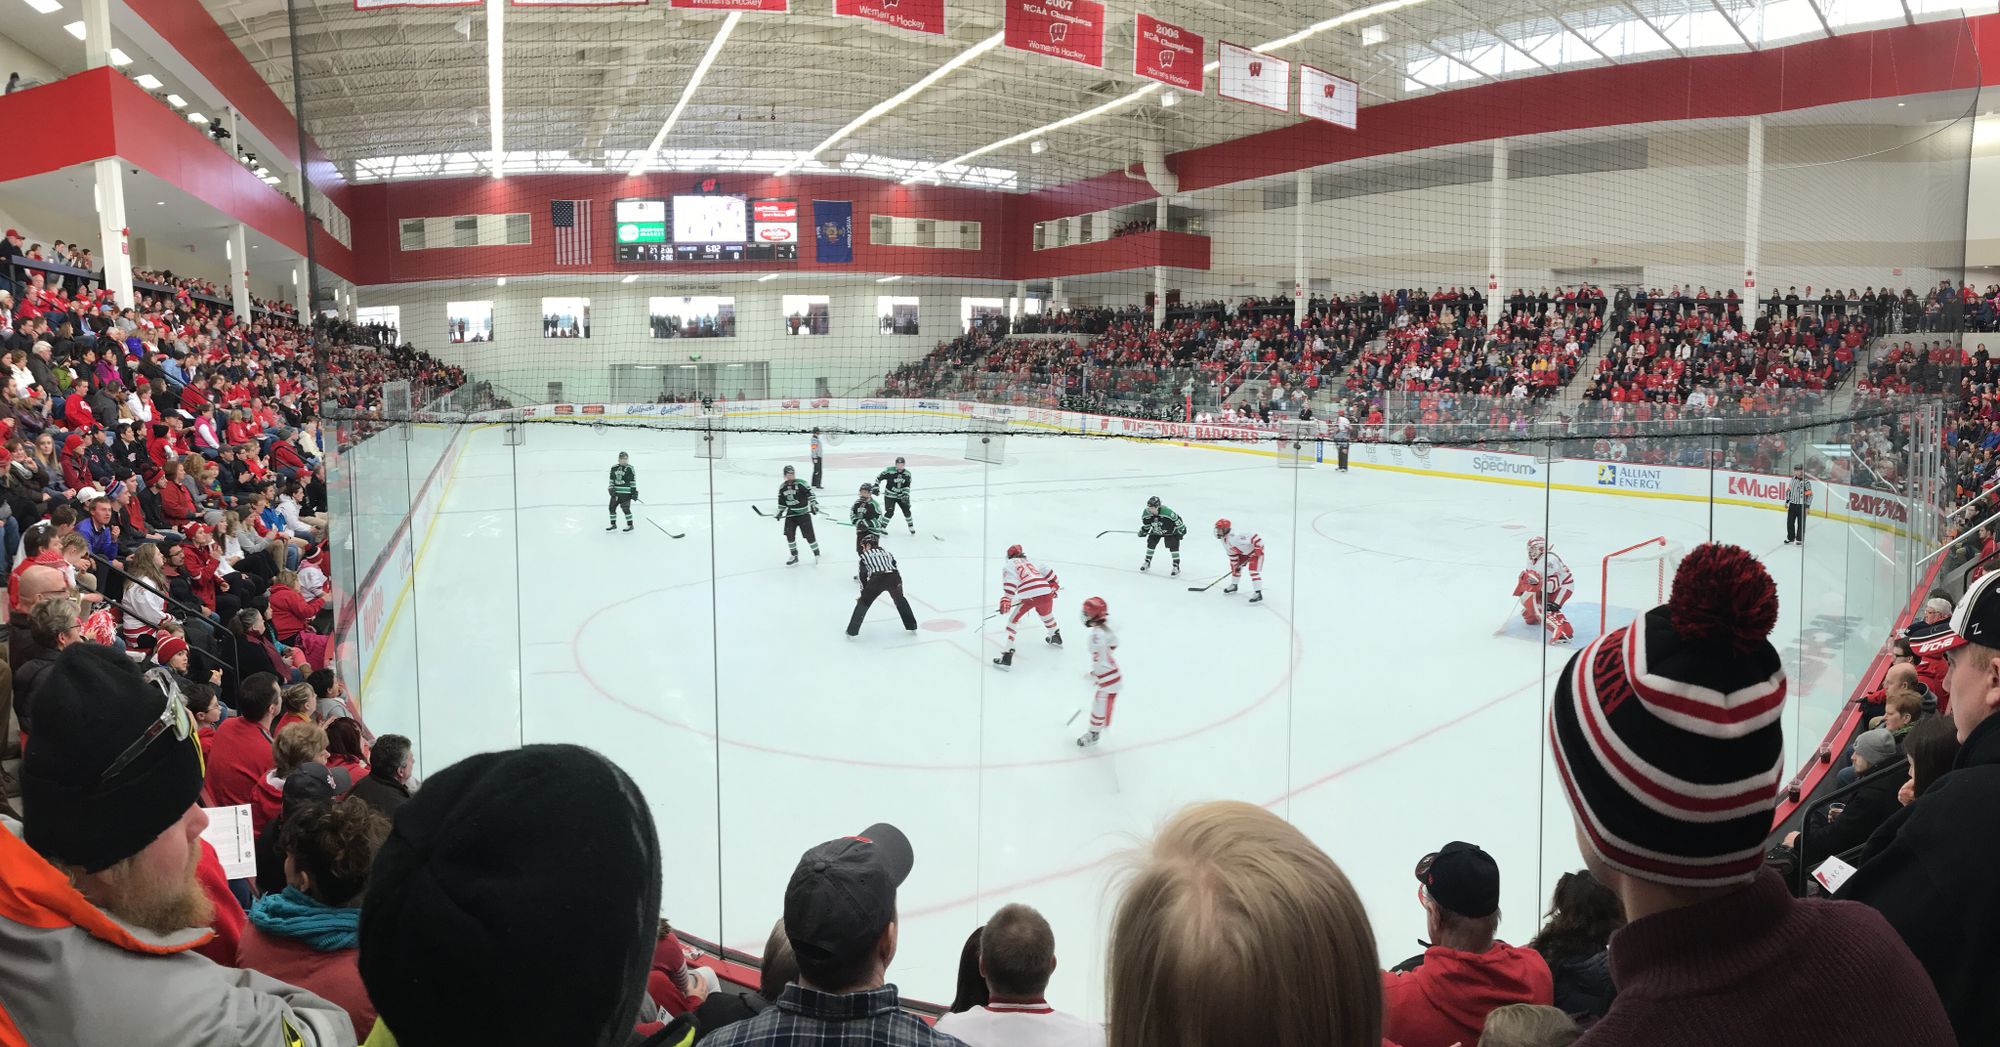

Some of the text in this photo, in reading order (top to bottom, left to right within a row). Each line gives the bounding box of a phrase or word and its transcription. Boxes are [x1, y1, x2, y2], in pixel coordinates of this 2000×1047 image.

[859, 5, 925, 31] Women's Hockey
[1023, 4, 1092, 27] NCAA Champions
[1062, 47, 1086, 60] Hockey
[1122, 419, 1259, 444] WINSIN BADGERS
[1473, 457, 1532, 475] Spectrum
[1619, 467, 1661, 479] ALLIANT
[1619, 478, 1661, 490] ENERGY
[1743, 477, 1787, 501] Muell
[1846, 491, 1907, 524] RAYOVA
[1919, 637, 1954, 653] WCHA
